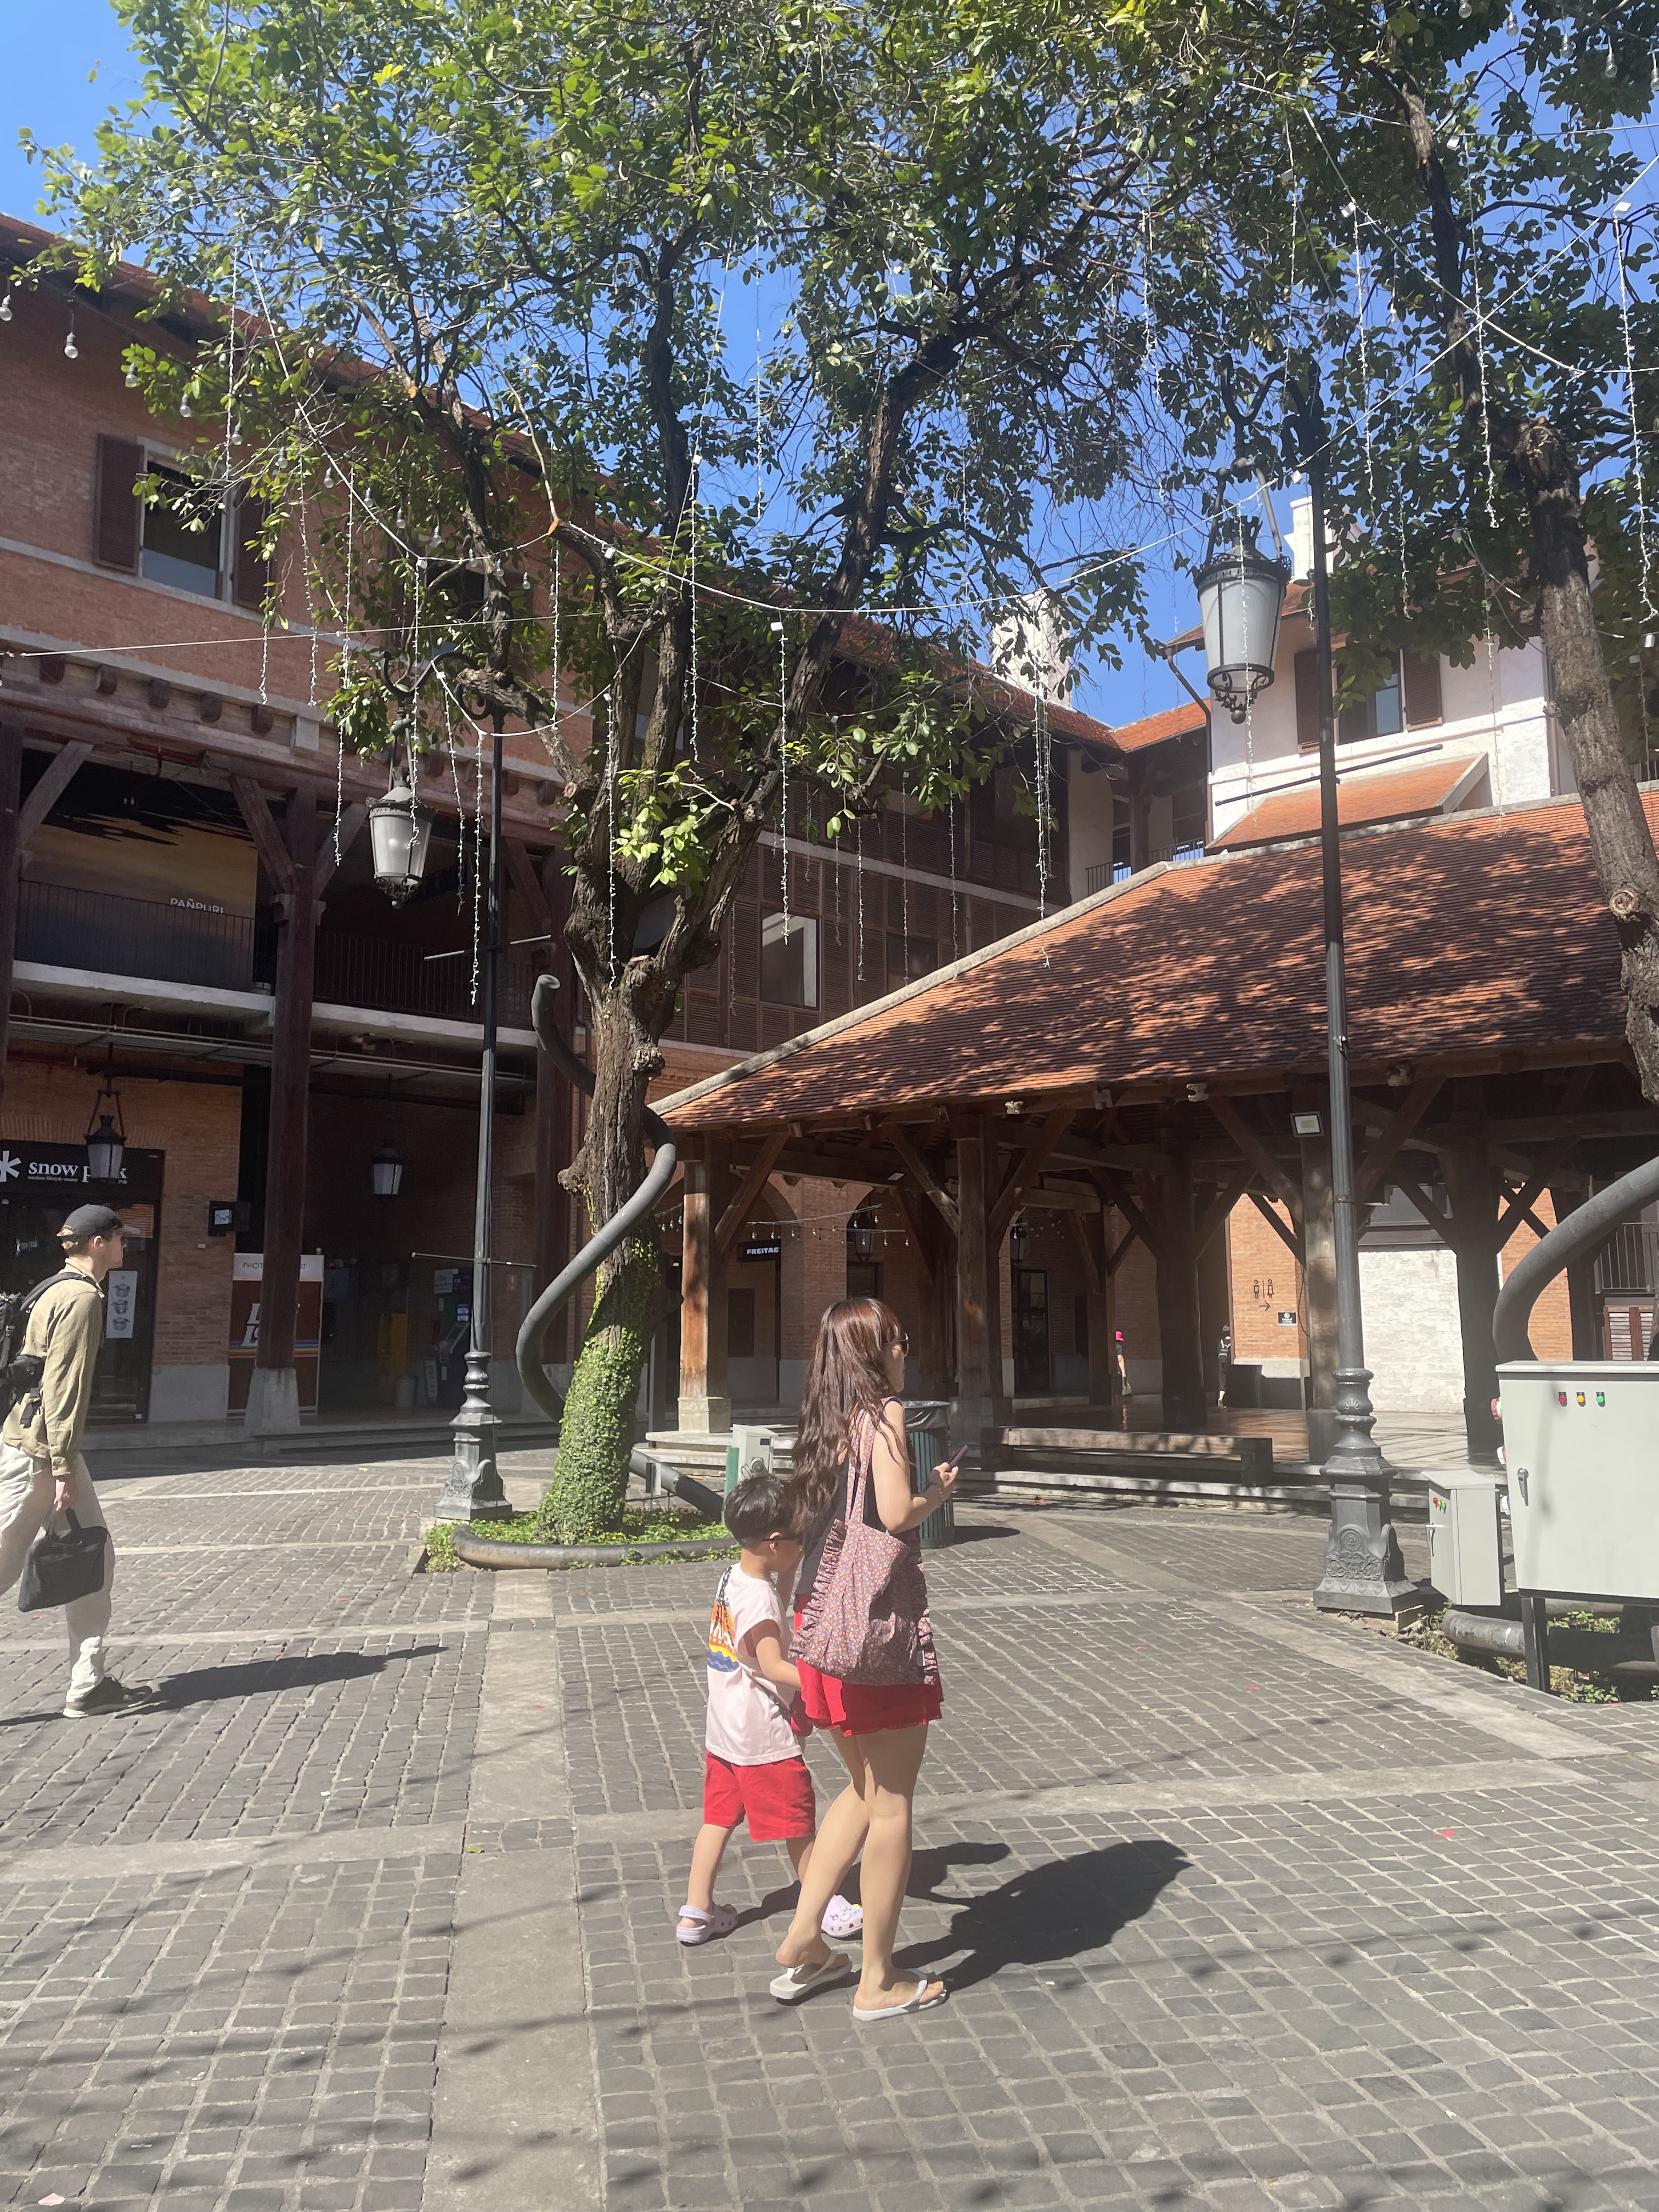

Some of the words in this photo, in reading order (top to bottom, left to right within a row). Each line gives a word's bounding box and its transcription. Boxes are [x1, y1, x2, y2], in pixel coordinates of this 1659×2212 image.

[170, 898, 223, 913] PAÑPURI
[29, 1162, 78, 1176] snow
[746, 1246, 779, 1255] FREITAG
